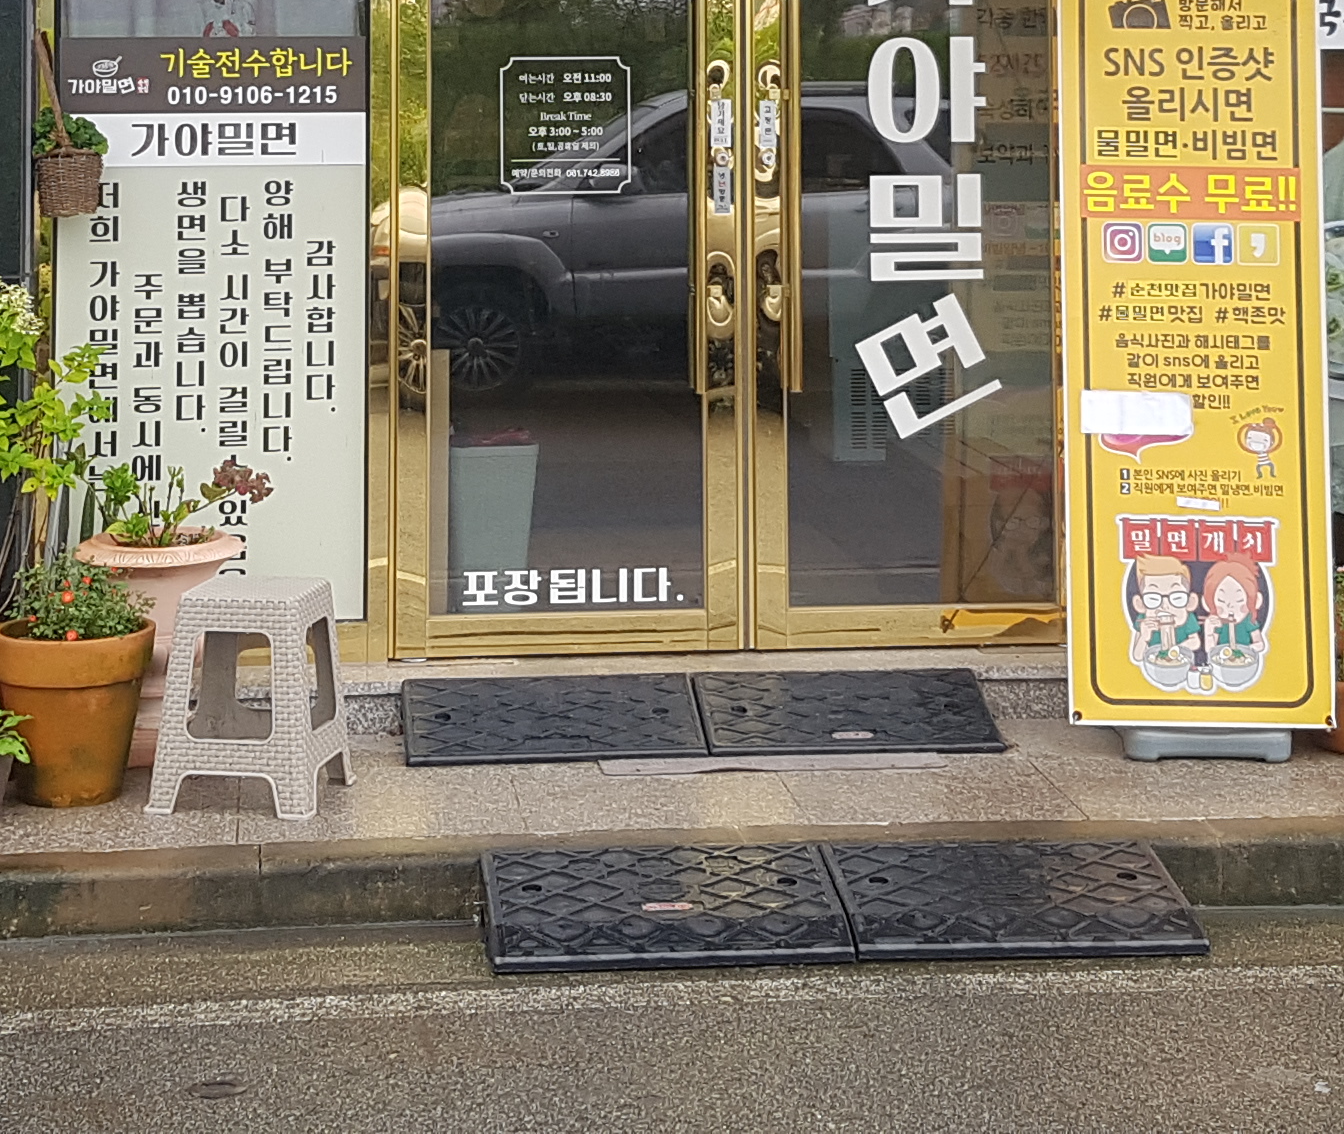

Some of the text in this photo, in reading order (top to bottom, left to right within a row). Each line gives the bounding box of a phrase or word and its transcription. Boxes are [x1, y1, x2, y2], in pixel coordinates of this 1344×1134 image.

[1178, 15, 1267, 31] 찍고, 올리고
[160, 47, 353, 79] 기술전수합니다
[1104, 46, 1274, 81] SNS 인증샷
[67, 76, 136, 95] 가야밀면
[563, 72, 582, 84] 오전
[584, 73, 612, 83] 11:00
[167, 85, 339, 106] 010-9106-1215
[563, 91, 582, 103] 오후
[583, 92, 612, 102] 08:30
[1122, 86, 1253, 122] 올리시면
[540, 111, 592, 121] Break Time
[131, 122, 298, 158] 가야밀면
[528, 126, 548, 137] 오후
[549, 126, 572, 137] 3:00
[581, 126, 604, 136] 5:00
[1083, 171, 1297, 214] 음료수 무료!!
[219, 195, 250, 256] 다소
[1153, 232, 1182, 246] blog
[175, 180, 207, 433] 생면을 뽑습니다.
[134, 273, 164, 368] 주문과
[219, 273, 249, 368] 시간이
[262, 179, 294, 462] 양해 부탁드립니다.
[306, 240, 337, 413] 감사합니다.
[1115, 333, 1271, 351] 음식사진과 해시태그를
[1126, 353, 1260, 370] 같이 sns에 올리고
[1127, 373, 1260, 390] 직원에게 보여주면
[1192, 394, 1231, 410] 할인!!
[218, 386, 248, 447] 걸릴
[132, 386, 162, 482] 동시에
[1133, 468, 1153, 480] 본인
[1156, 469, 1185, 481] SNS에
[1188, 469, 1208, 482] 사진
[1211, 470, 1241, 482] 올리기
[1133, 482, 1174, 495] 직원에게
[1176, 483, 1217, 496] 보여주면
[1130, 529, 1263, 554] 밀면개시
